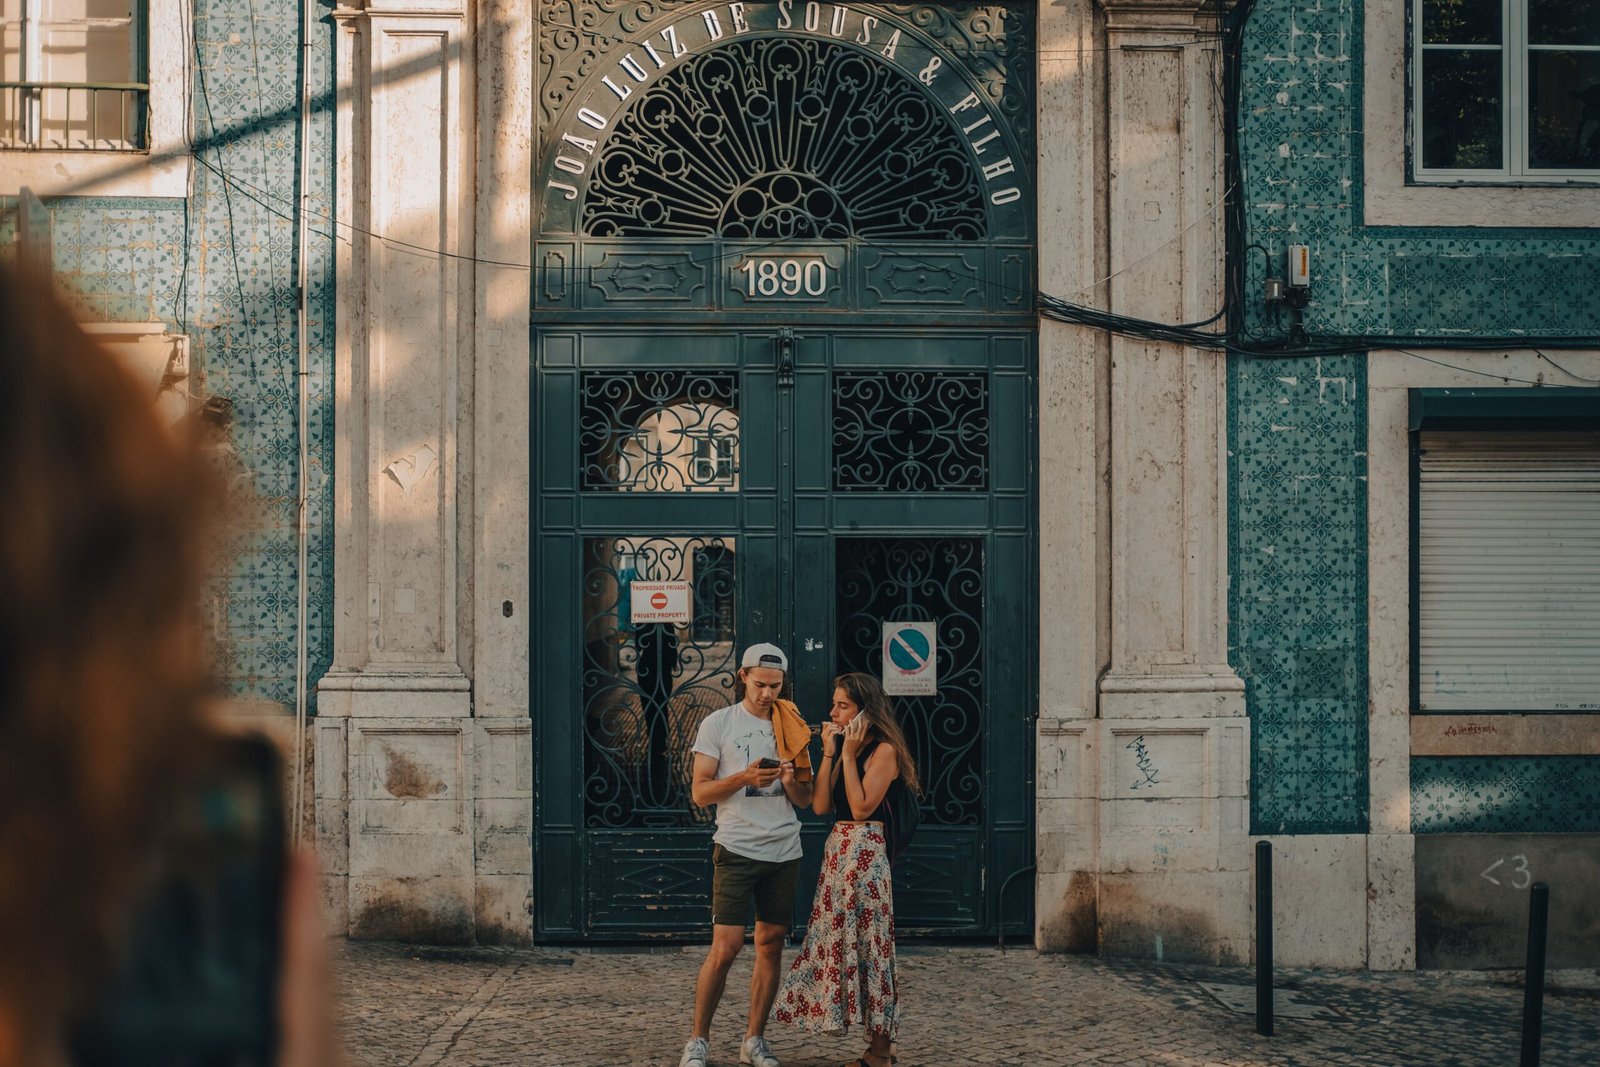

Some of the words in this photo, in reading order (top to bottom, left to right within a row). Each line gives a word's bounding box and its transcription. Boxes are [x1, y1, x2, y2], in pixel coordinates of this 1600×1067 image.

[548, 107, 607, 200] JOAO
[601, 25, 687, 101] LUIZ
[702, 2, 749, 42] DE
[777, 0, 901, 60] SOUSA
[919, 56, 942, 86] &
[950, 91, 1021, 206] FILHO
[742, 259, 827, 298] 1890
